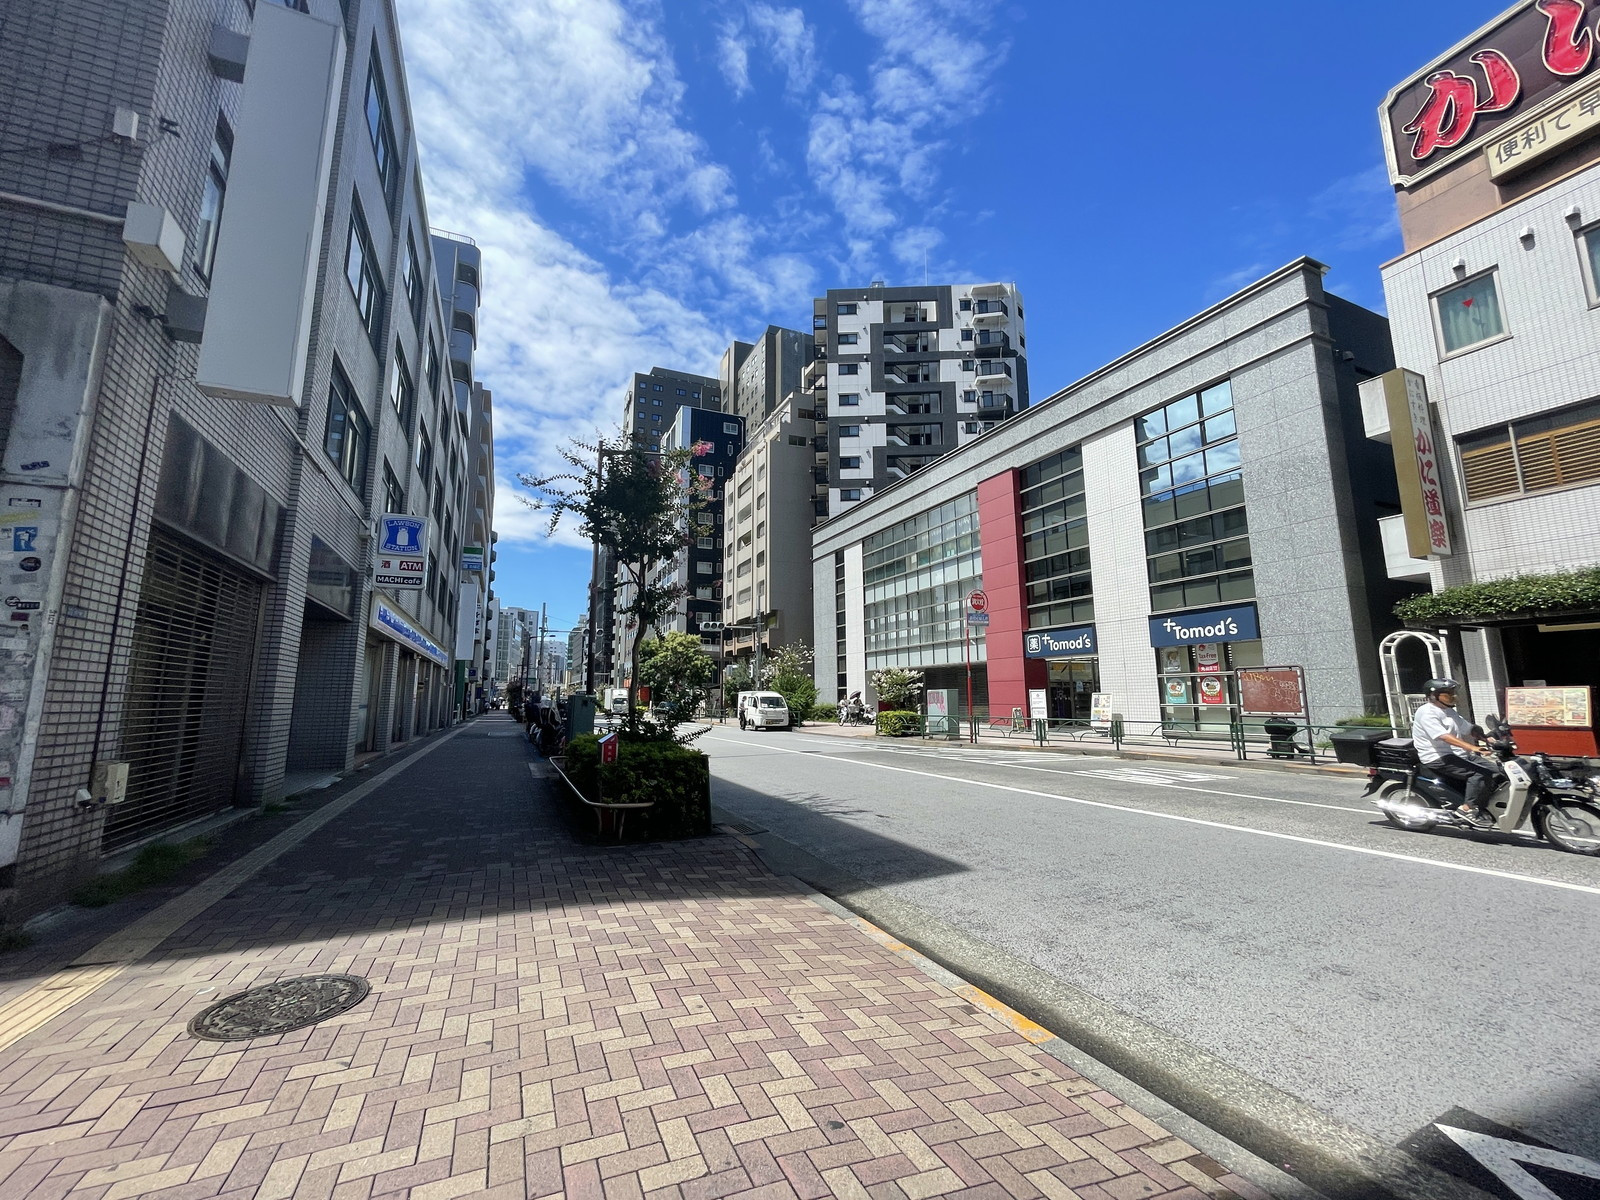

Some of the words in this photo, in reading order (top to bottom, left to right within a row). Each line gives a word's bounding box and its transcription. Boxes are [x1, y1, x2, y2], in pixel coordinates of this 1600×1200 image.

[387, 520, 420, 529] LAWSON
[386, 543, 418, 552] STATION
[401, 562, 422, 571] ATM
[377, 576, 403, 584] MACHI
[1173, 617, 1238, 640] Tomod's
[1029, 637, 1039, 650] 薬
[1048, 634, 1091, 651] Tomod's
